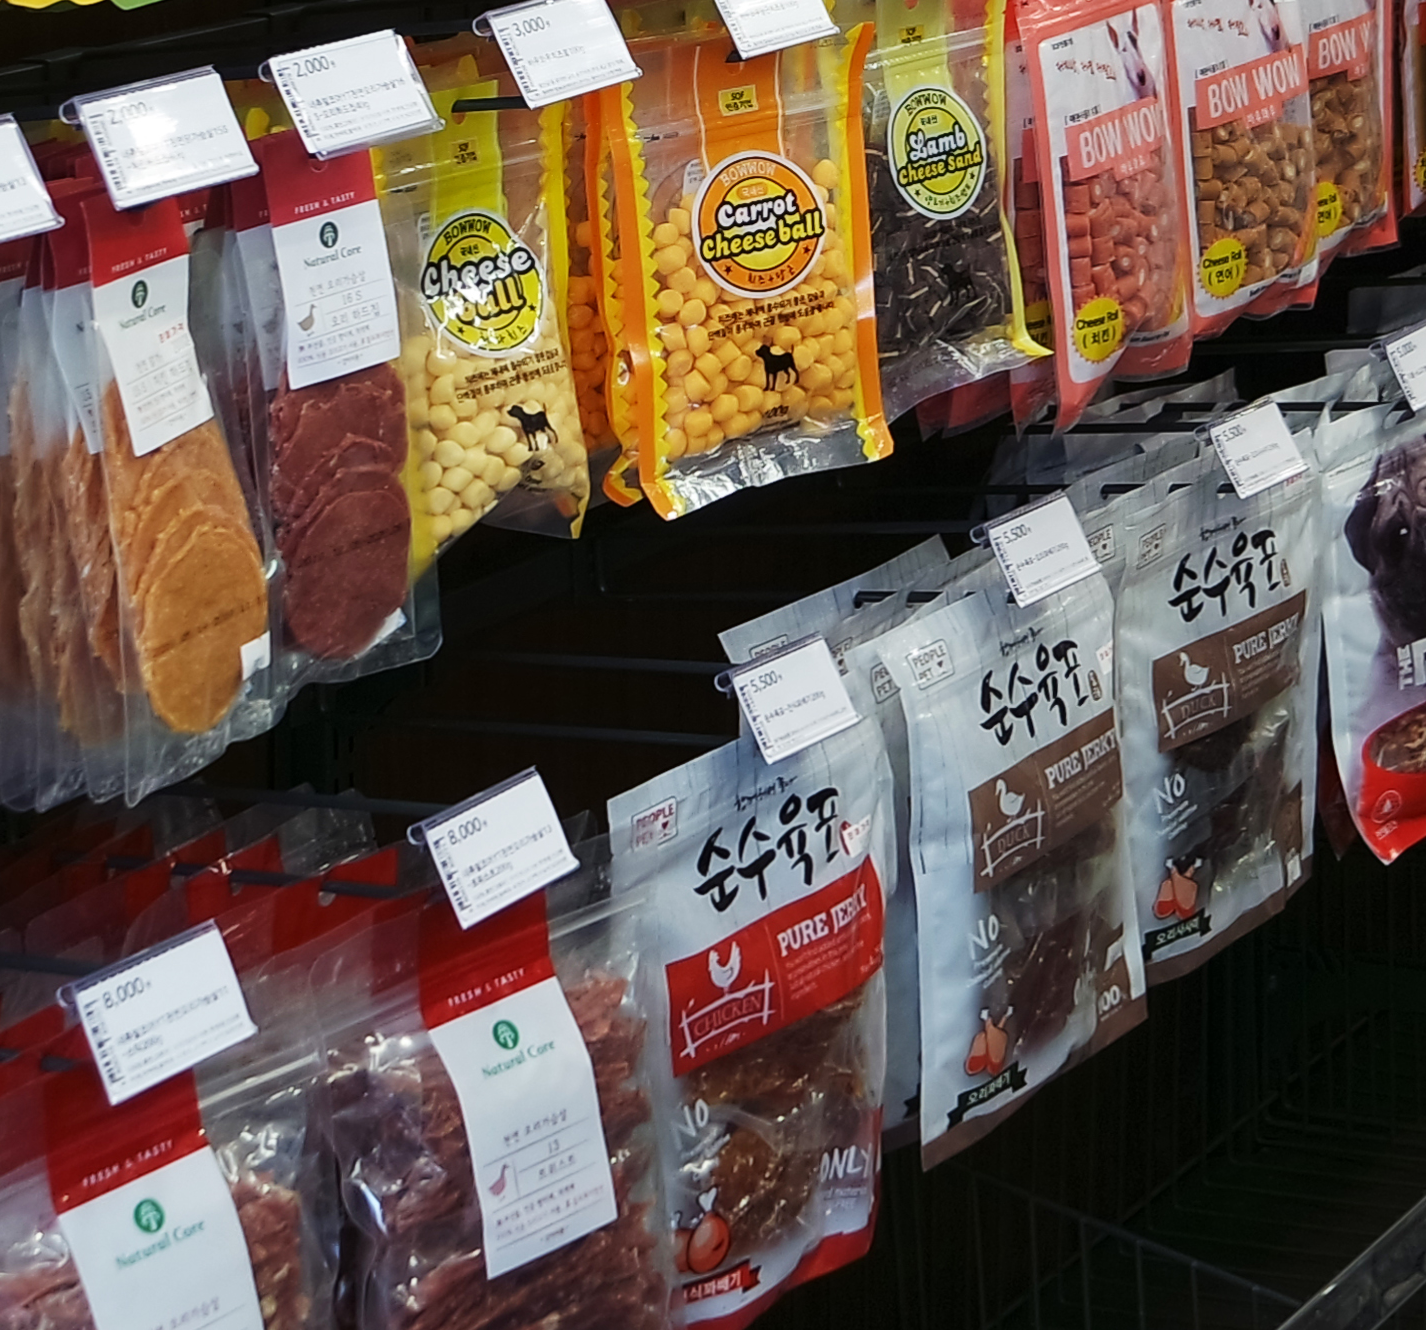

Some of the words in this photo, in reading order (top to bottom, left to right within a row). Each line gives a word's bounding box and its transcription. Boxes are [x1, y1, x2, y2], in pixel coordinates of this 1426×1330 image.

[1317, 28, 1357, 70] BOW
[905, 92, 947, 117] BOWWOW
[1207, 72, 1250, 119] BOW
[1252, 52, 1301, 101] WOW
[909, 124, 966, 160] Lamb
[947, 145, 983, 168] Sand
[1079, 119, 1122, 169] BOW
[721, 159, 776, 187] BOWWOW
[717, 190, 797, 228] Carrot
[778, 210, 824, 243] ball
[443, 218, 492, 246] BOWWOW
[303, 248, 339, 270] Natural
[340, 244, 363, 259] Core
[422, 248, 533, 299] Cheese
[1202, 253, 1230, 270] Cheese
[1075, 313, 1105, 331] Cheese
[1167, 528, 1282, 623] 순수육포
[911, 644, 948, 669] PEOPLE
[1232, 631, 1266, 665] PURE
[1396, 644, 1413, 691] THE
[979, 639, 1089, 747] 순수육포
[1181, 693, 1217, 720] DUCK
[1045, 751, 1082, 789] PURE
[1080, 729, 1118, 771] JERKY
[1155, 770, 1186, 814] NO
[635, 802, 674, 831] PEOPLE
[692, 786, 841, 913] 순수육포
[997, 826, 1030, 855] DUCK
[777, 912, 830, 957] PURE
[447, 986, 483, 1008] FRESH
[493, 968, 526, 989] TASTY
[694, 992, 764, 1037] CHICKEN
[481, 1050, 526, 1080] Natural
[526, 1039, 556, 1059] Core
[820, 1142, 874, 1183] ONLY
[116, 1232, 171, 1270] Natural
[172, 1219, 206, 1242] Core
